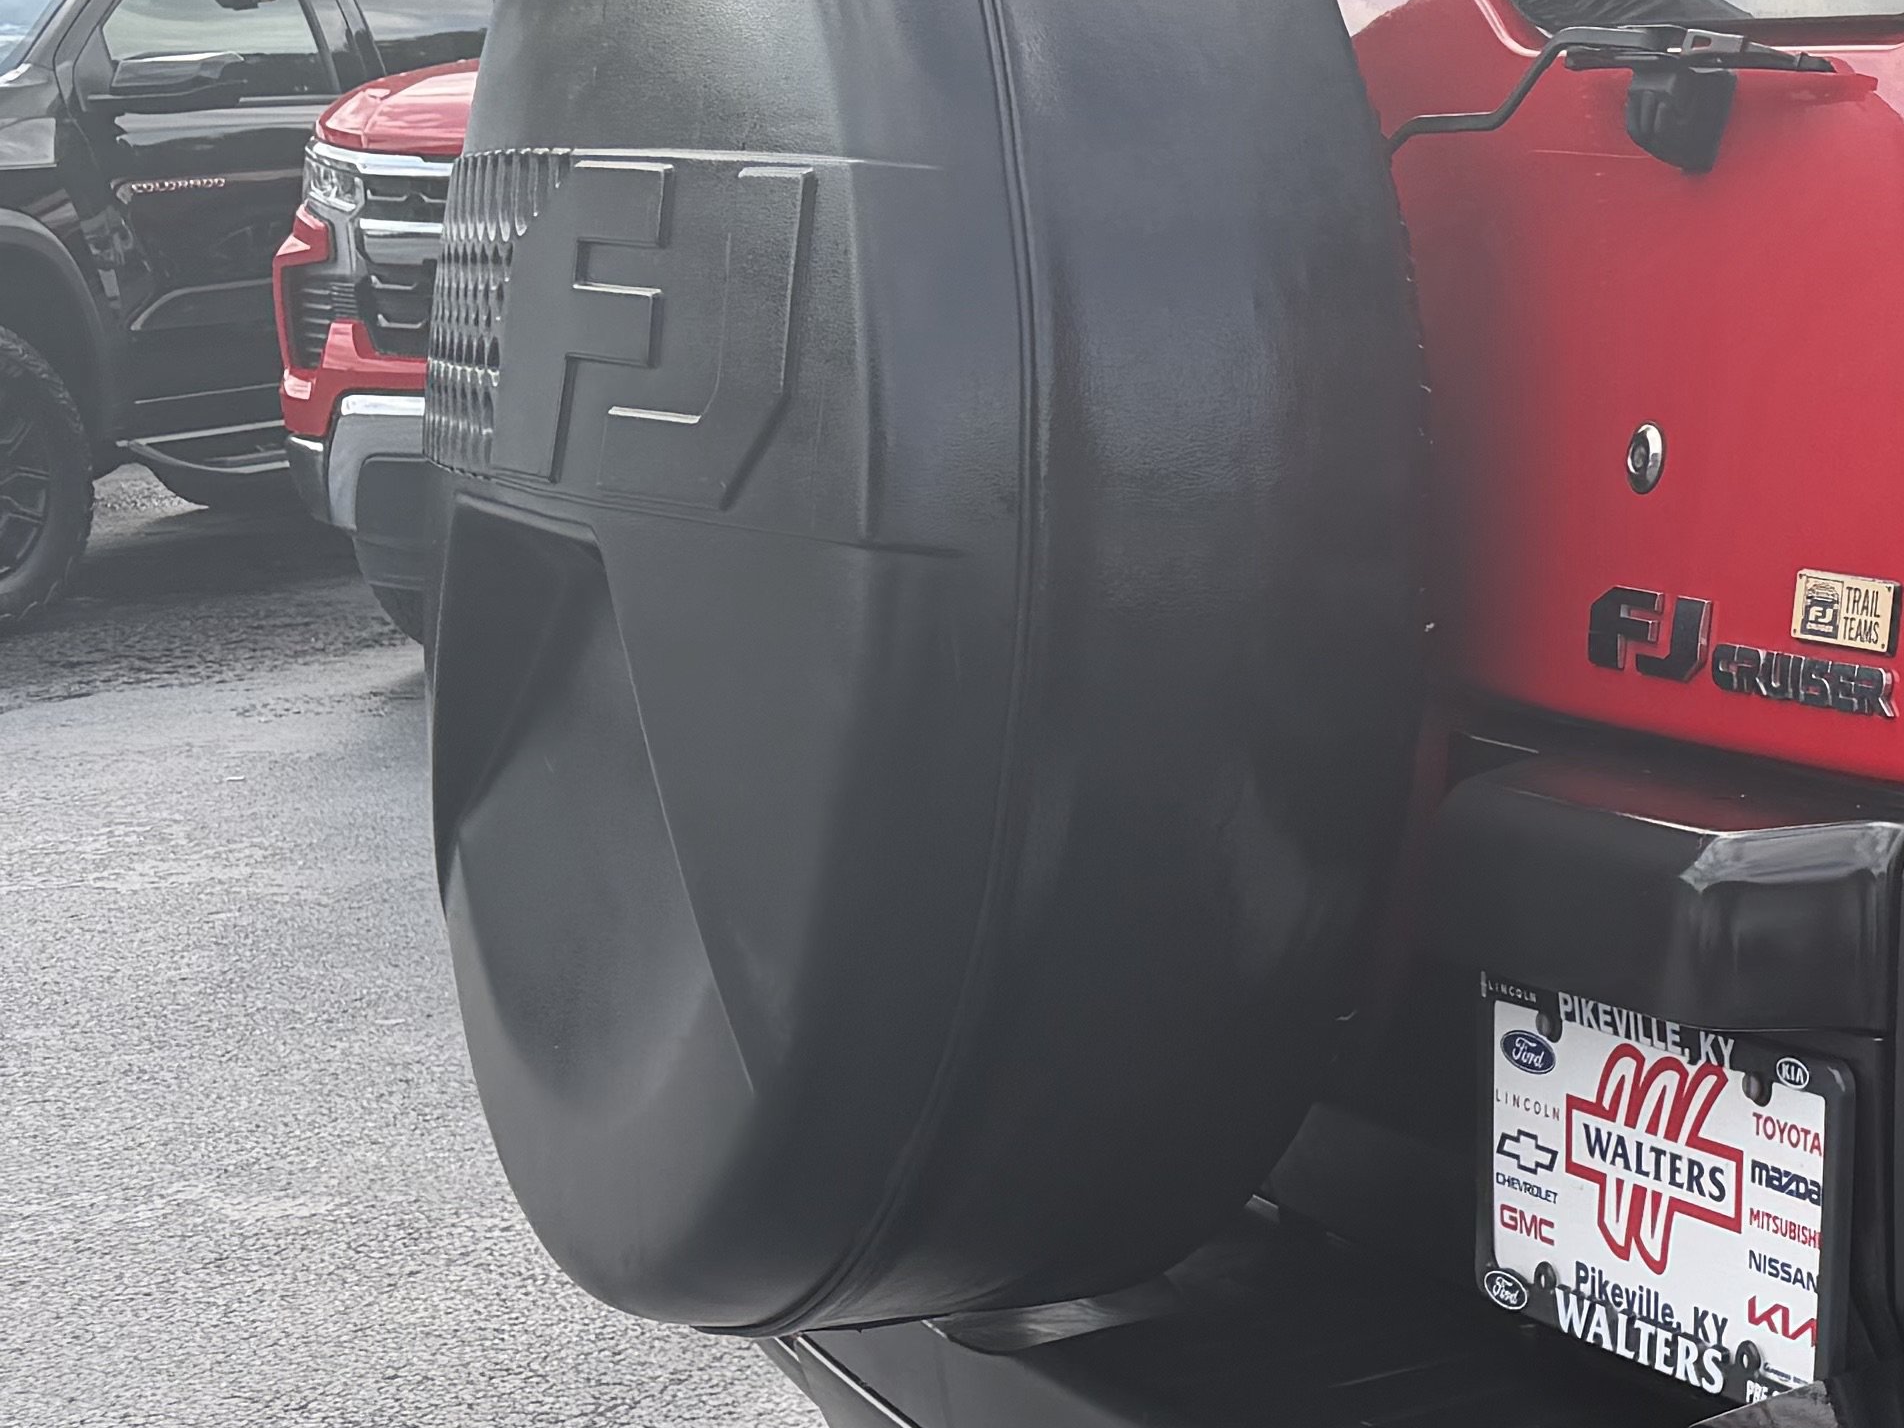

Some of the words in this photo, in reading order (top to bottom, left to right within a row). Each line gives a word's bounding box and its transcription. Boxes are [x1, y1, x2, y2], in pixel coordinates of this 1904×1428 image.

[489, 160, 819, 512] FJ
[1845, 586, 1881, 618] TRAIL
[1588, 584, 1713, 684] FJ
[1711, 643, 1899, 719] CRUISER
[1843, 616, 1880, 645] TEAMS
[1488, 979, 1537, 1003] LINCOLN
[1557, 991, 1690, 1060] PIKEVILLE,
[1699, 1032, 1736, 1070] KY
[1495, 1088, 1561, 1122] LINCOLN
[1752, 1111, 1823, 1157] TOYOTA
[1582, 1122, 1727, 1203] WALTERS
[1751, 1159, 1822, 1206] mazda
[1495, 1171, 1559, 1204] CHEVROLET
[1500, 1203, 1555, 1246] GMC
[1748, 1249, 1818, 1292] NISSAN
[1555, 1287, 1725, 1395] WALTERS
[1693, 1306, 1729, 1347] KY
